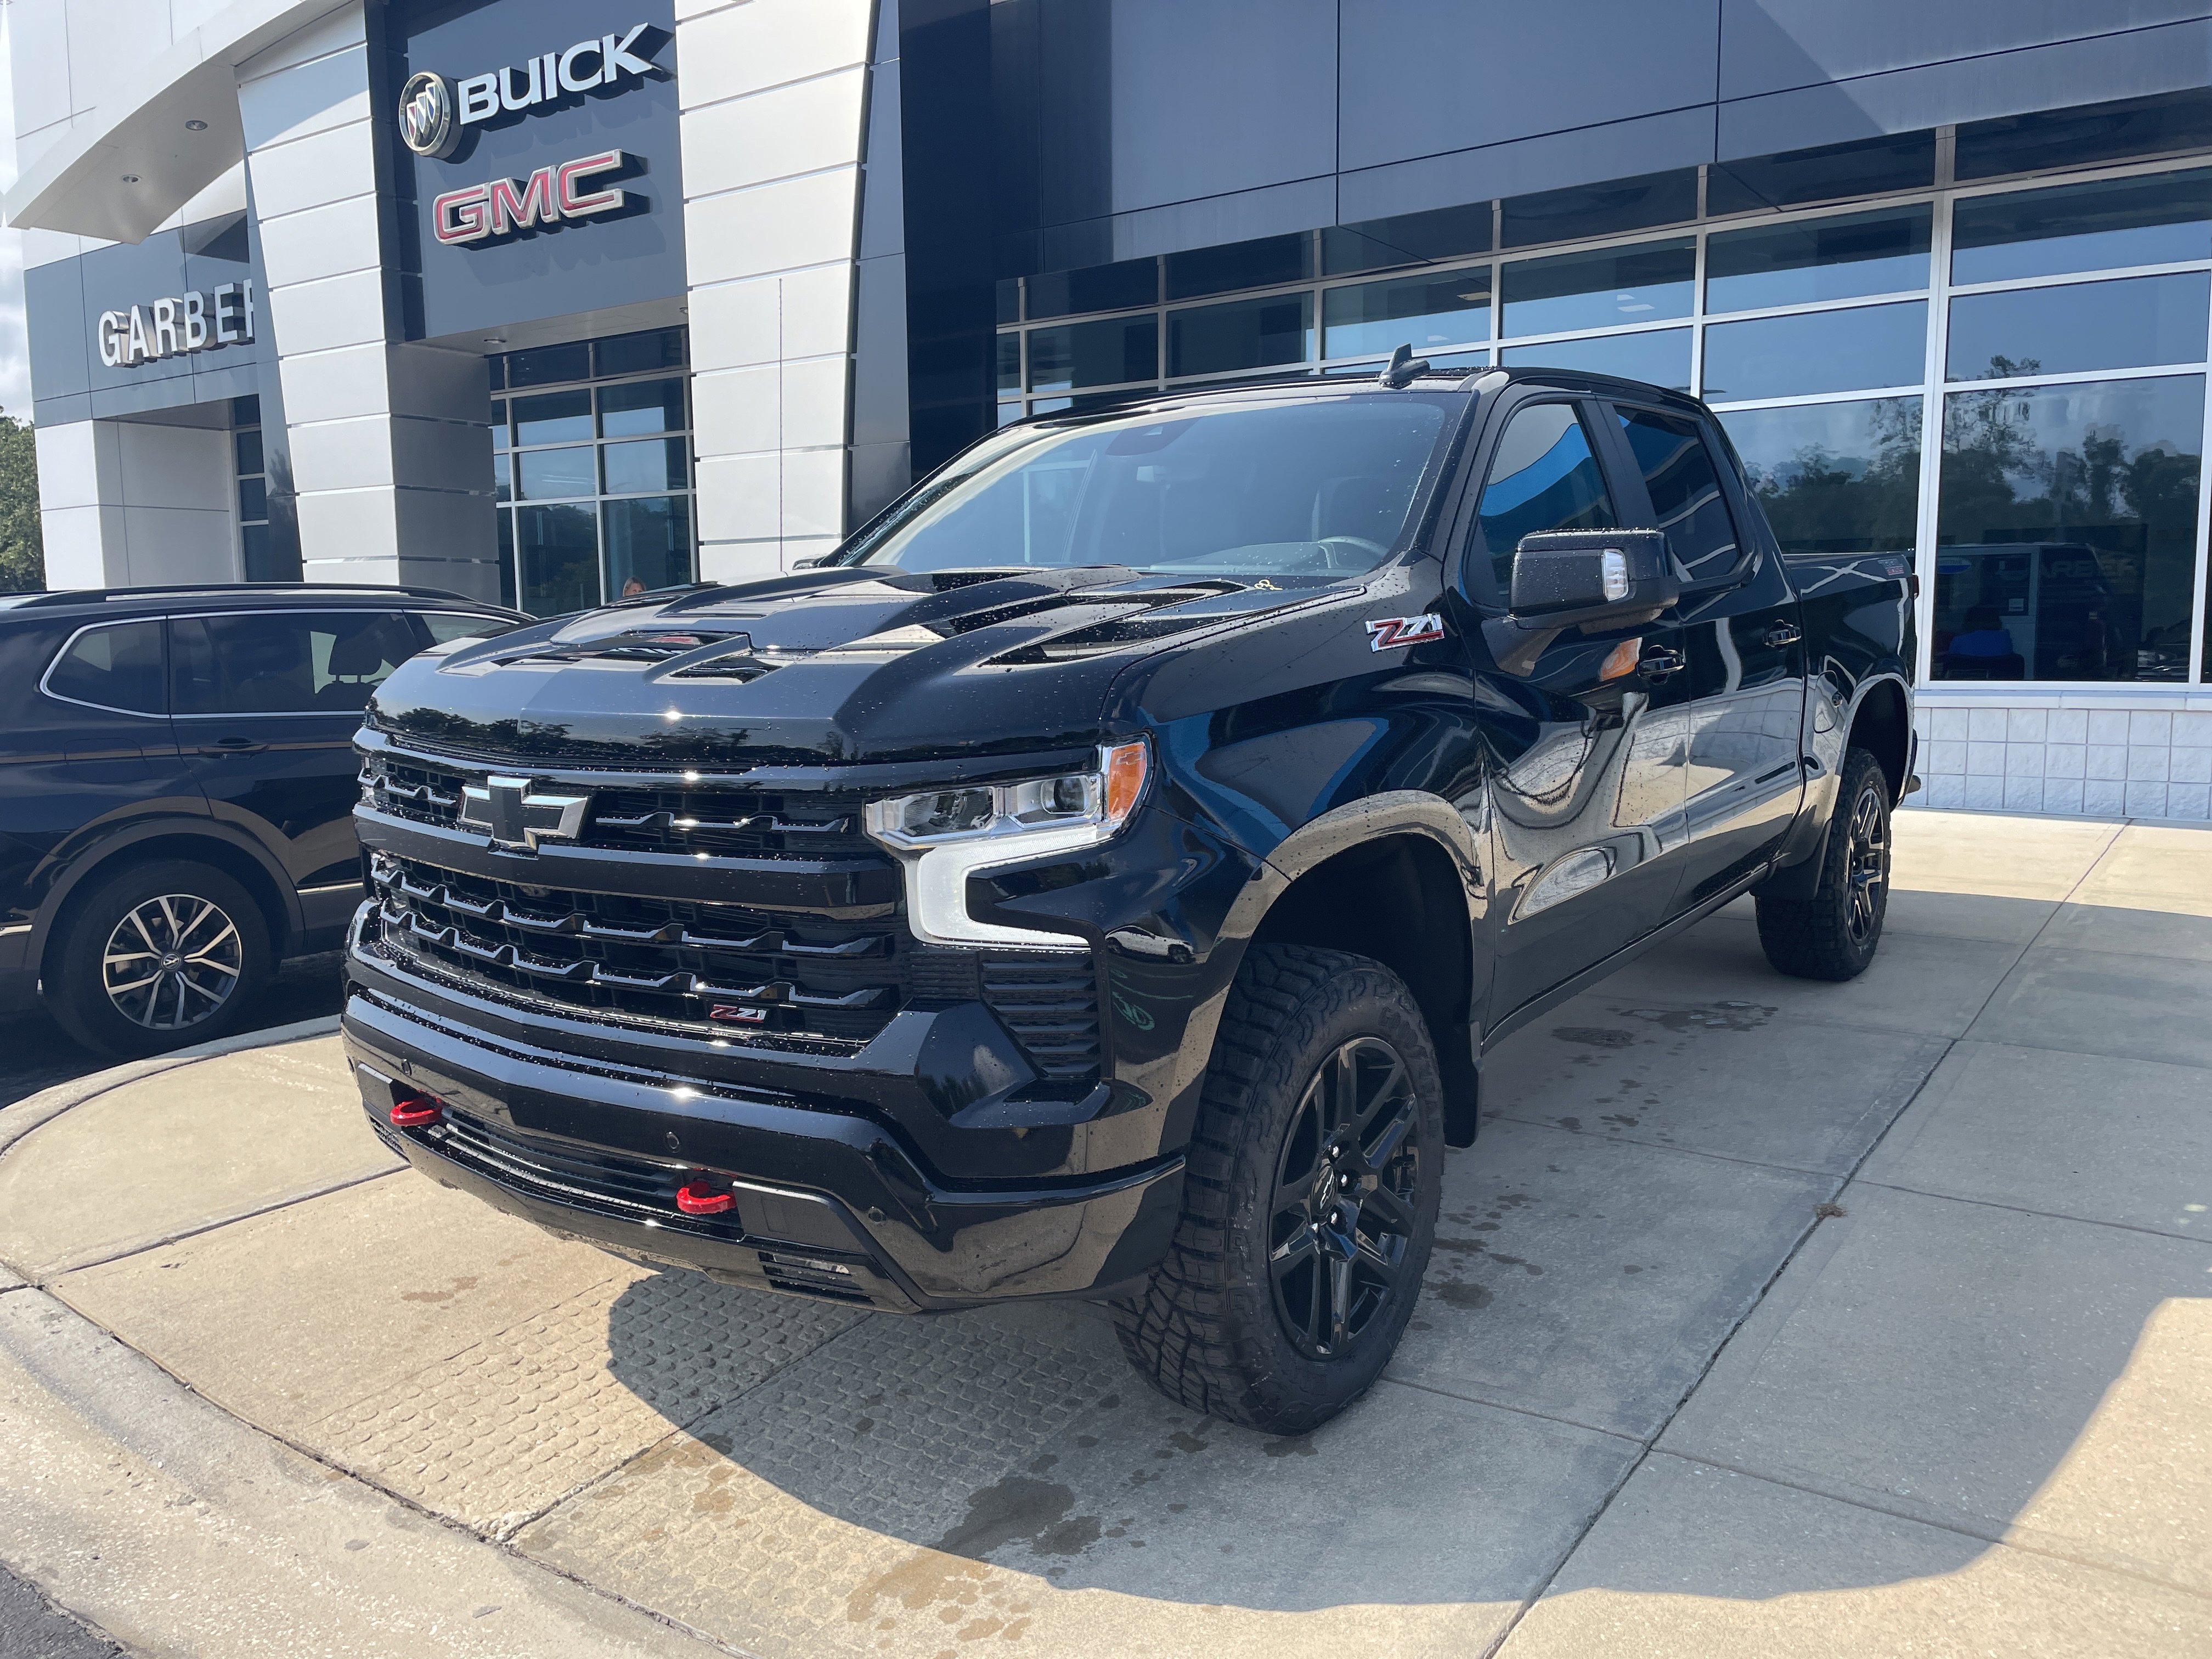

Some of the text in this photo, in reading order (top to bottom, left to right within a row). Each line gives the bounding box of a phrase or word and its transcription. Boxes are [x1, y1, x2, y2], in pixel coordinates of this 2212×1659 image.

[458, 22, 654, 125] BUICK
[432, 148, 624, 245] GMC
[1364, 612, 1445, 652] Z71
[709, 1004, 768, 1023] Z71
